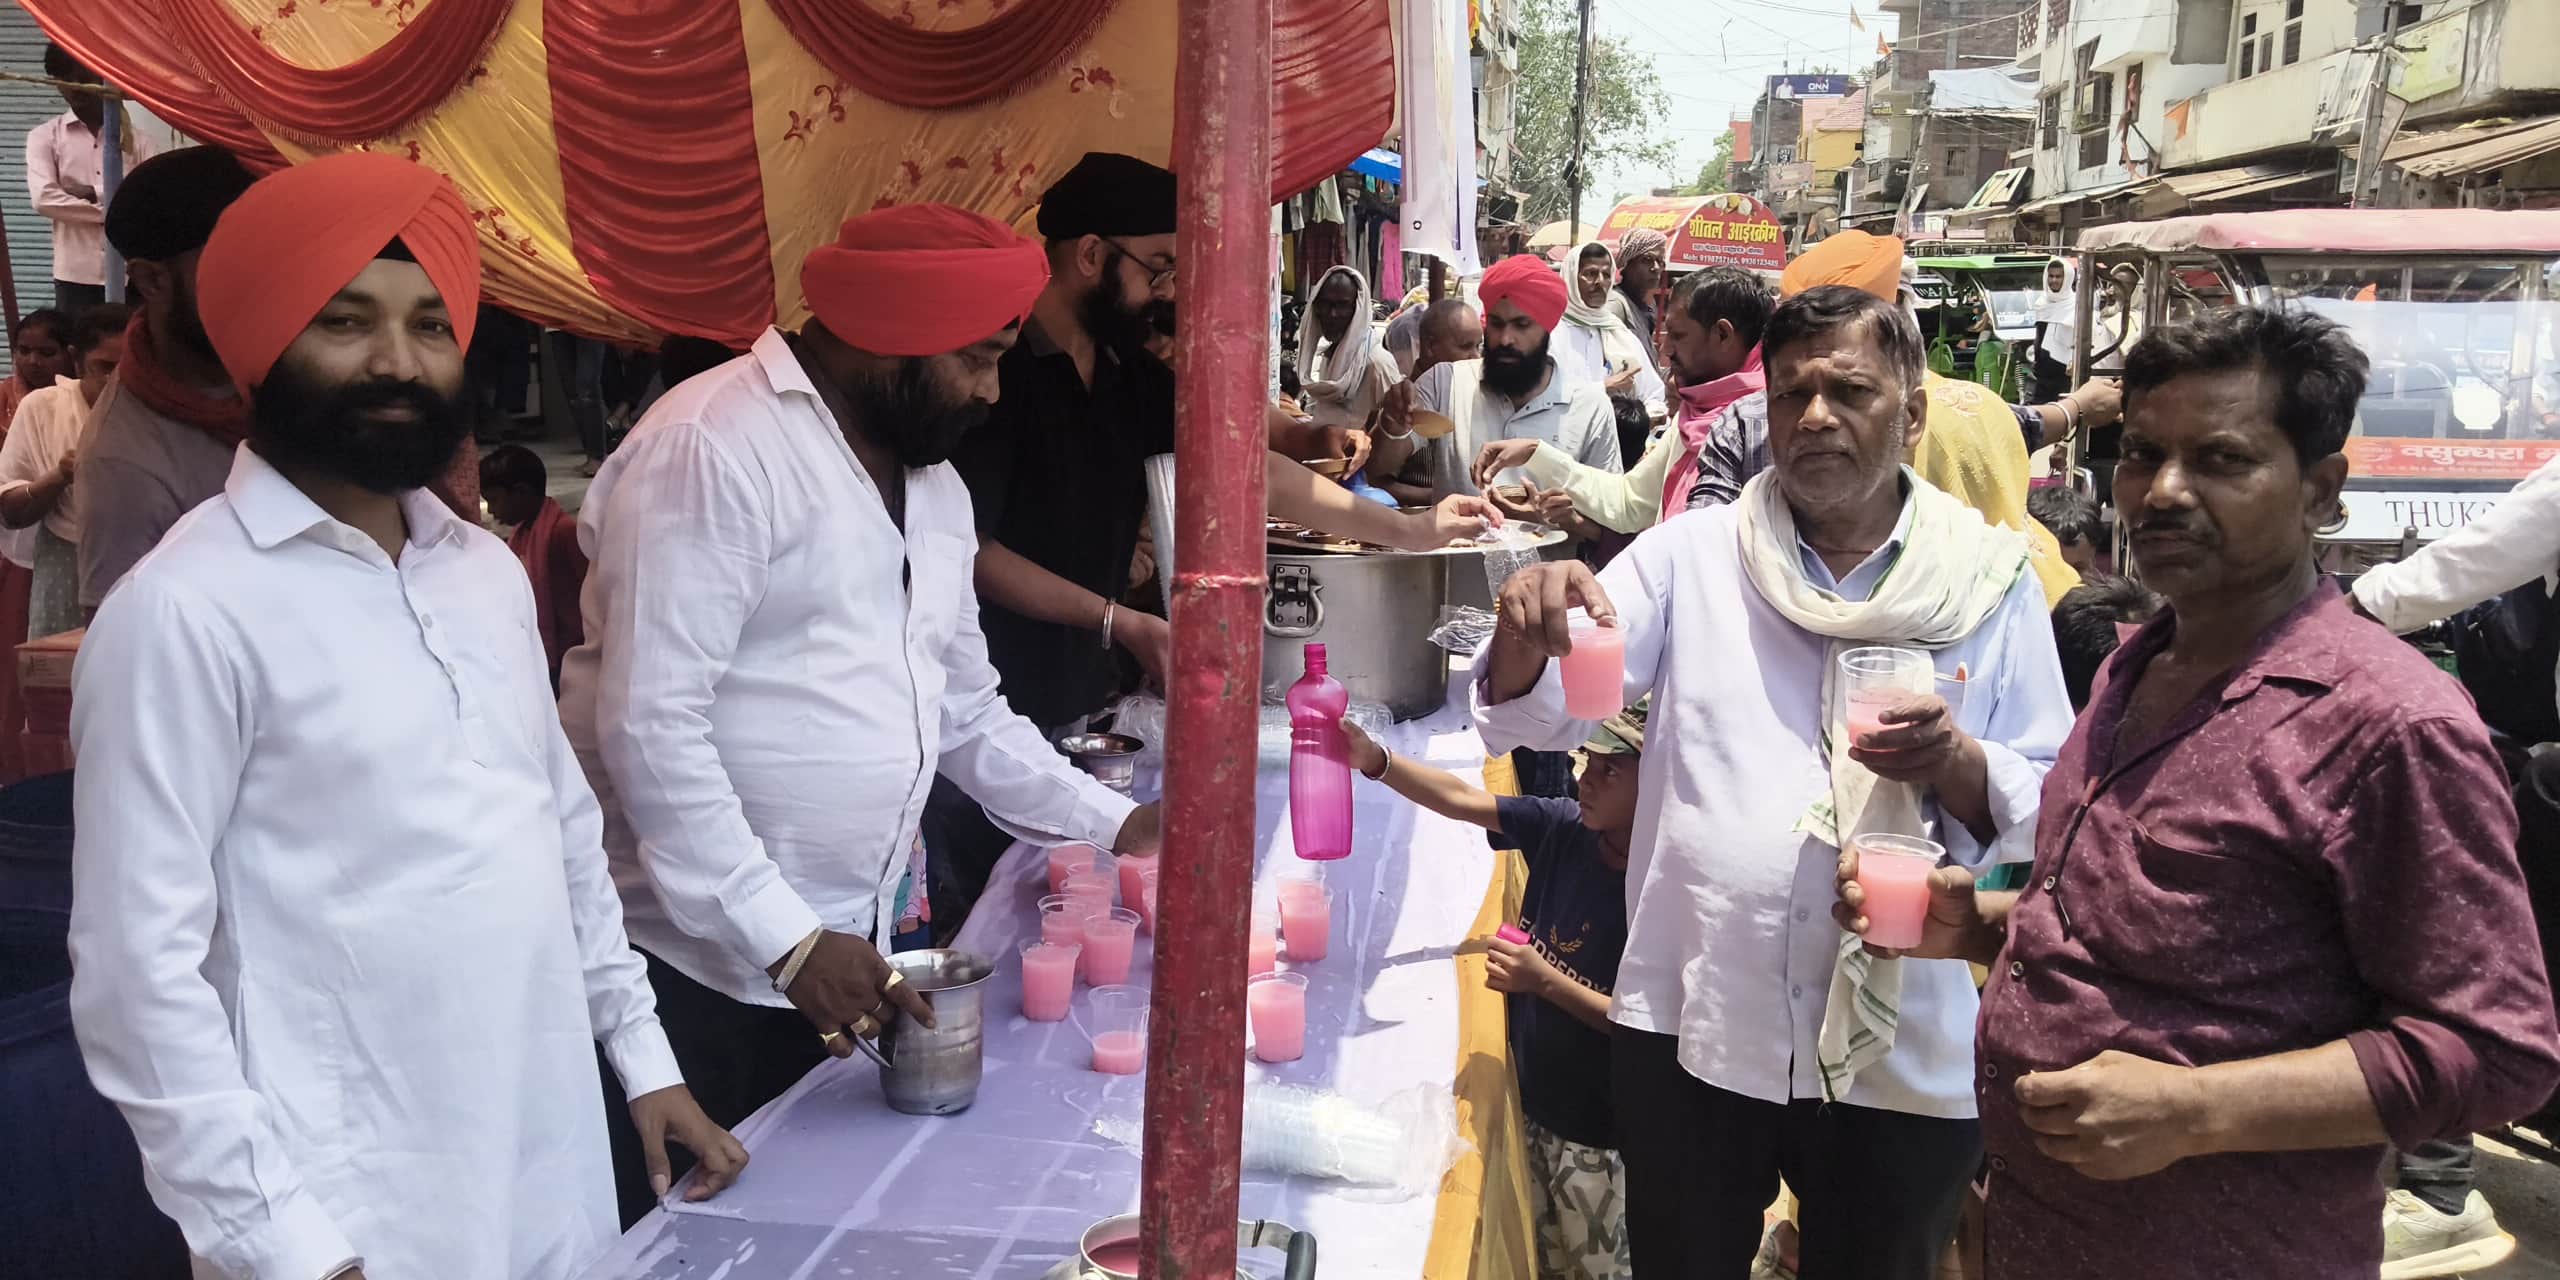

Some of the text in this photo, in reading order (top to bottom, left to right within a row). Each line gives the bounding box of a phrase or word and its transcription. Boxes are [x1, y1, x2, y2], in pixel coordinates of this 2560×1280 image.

[1808, 79, 1829, 90] ONN
[1688, 214, 1724, 239] शीतल
[2400, 444, 2526, 465] वसुन्धरा
